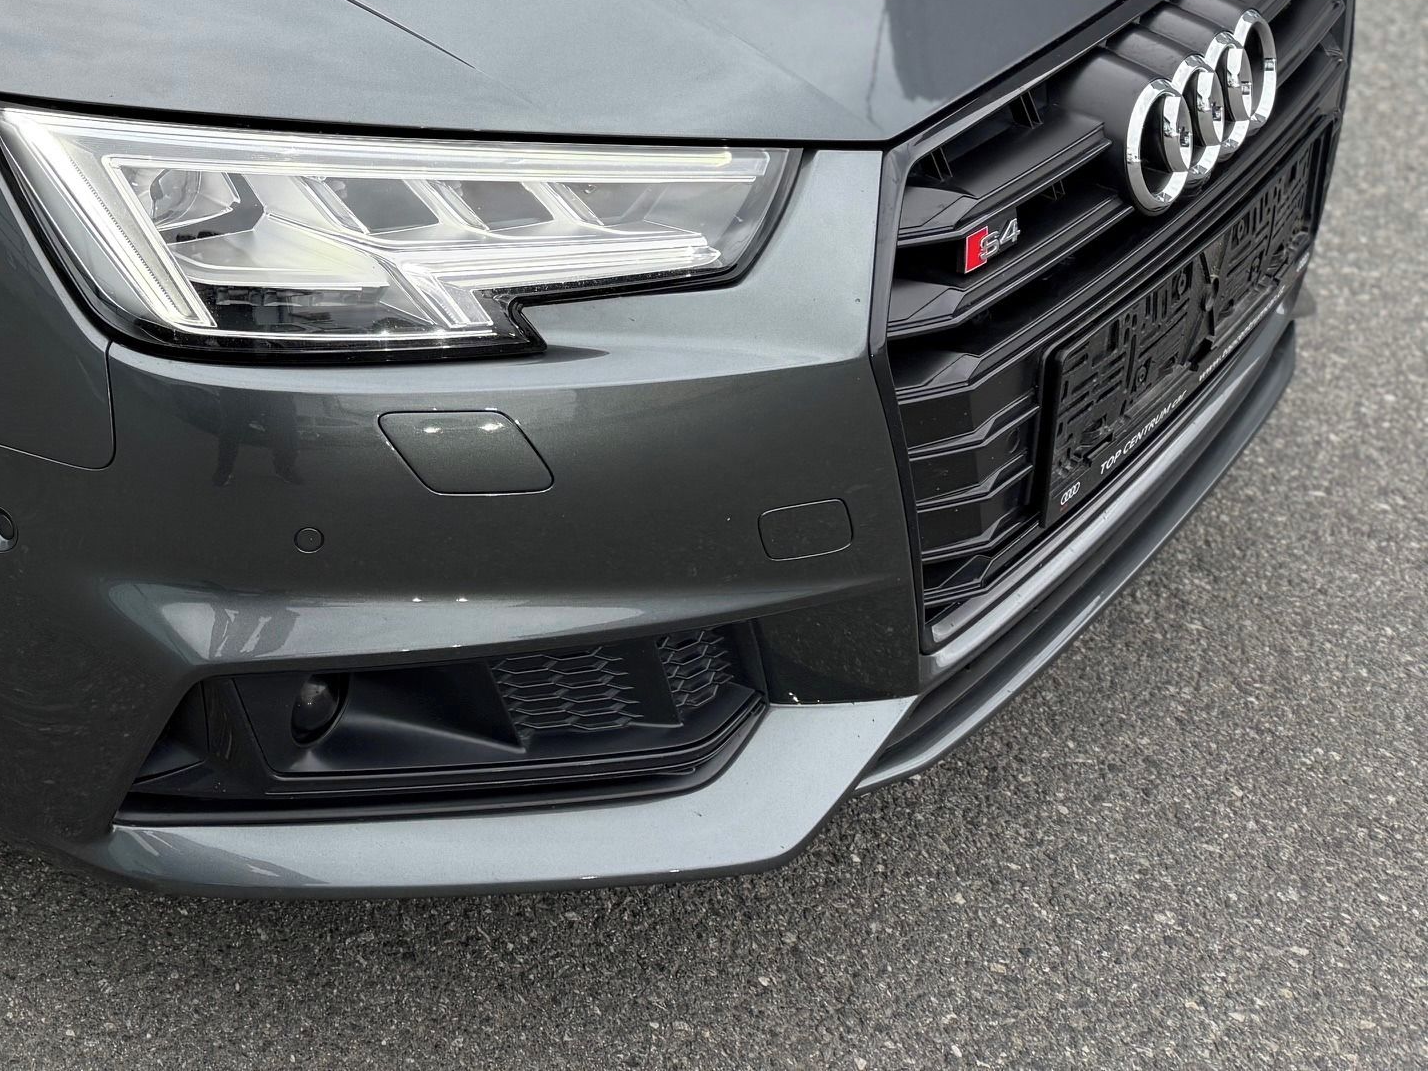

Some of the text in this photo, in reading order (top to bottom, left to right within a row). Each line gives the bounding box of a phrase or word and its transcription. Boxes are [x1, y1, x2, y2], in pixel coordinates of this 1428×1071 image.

[978, 218, 1021, 260] S4
[1100, 449, 1122, 475] TOP
[1122, 402, 1172, 455] CENTRUM
